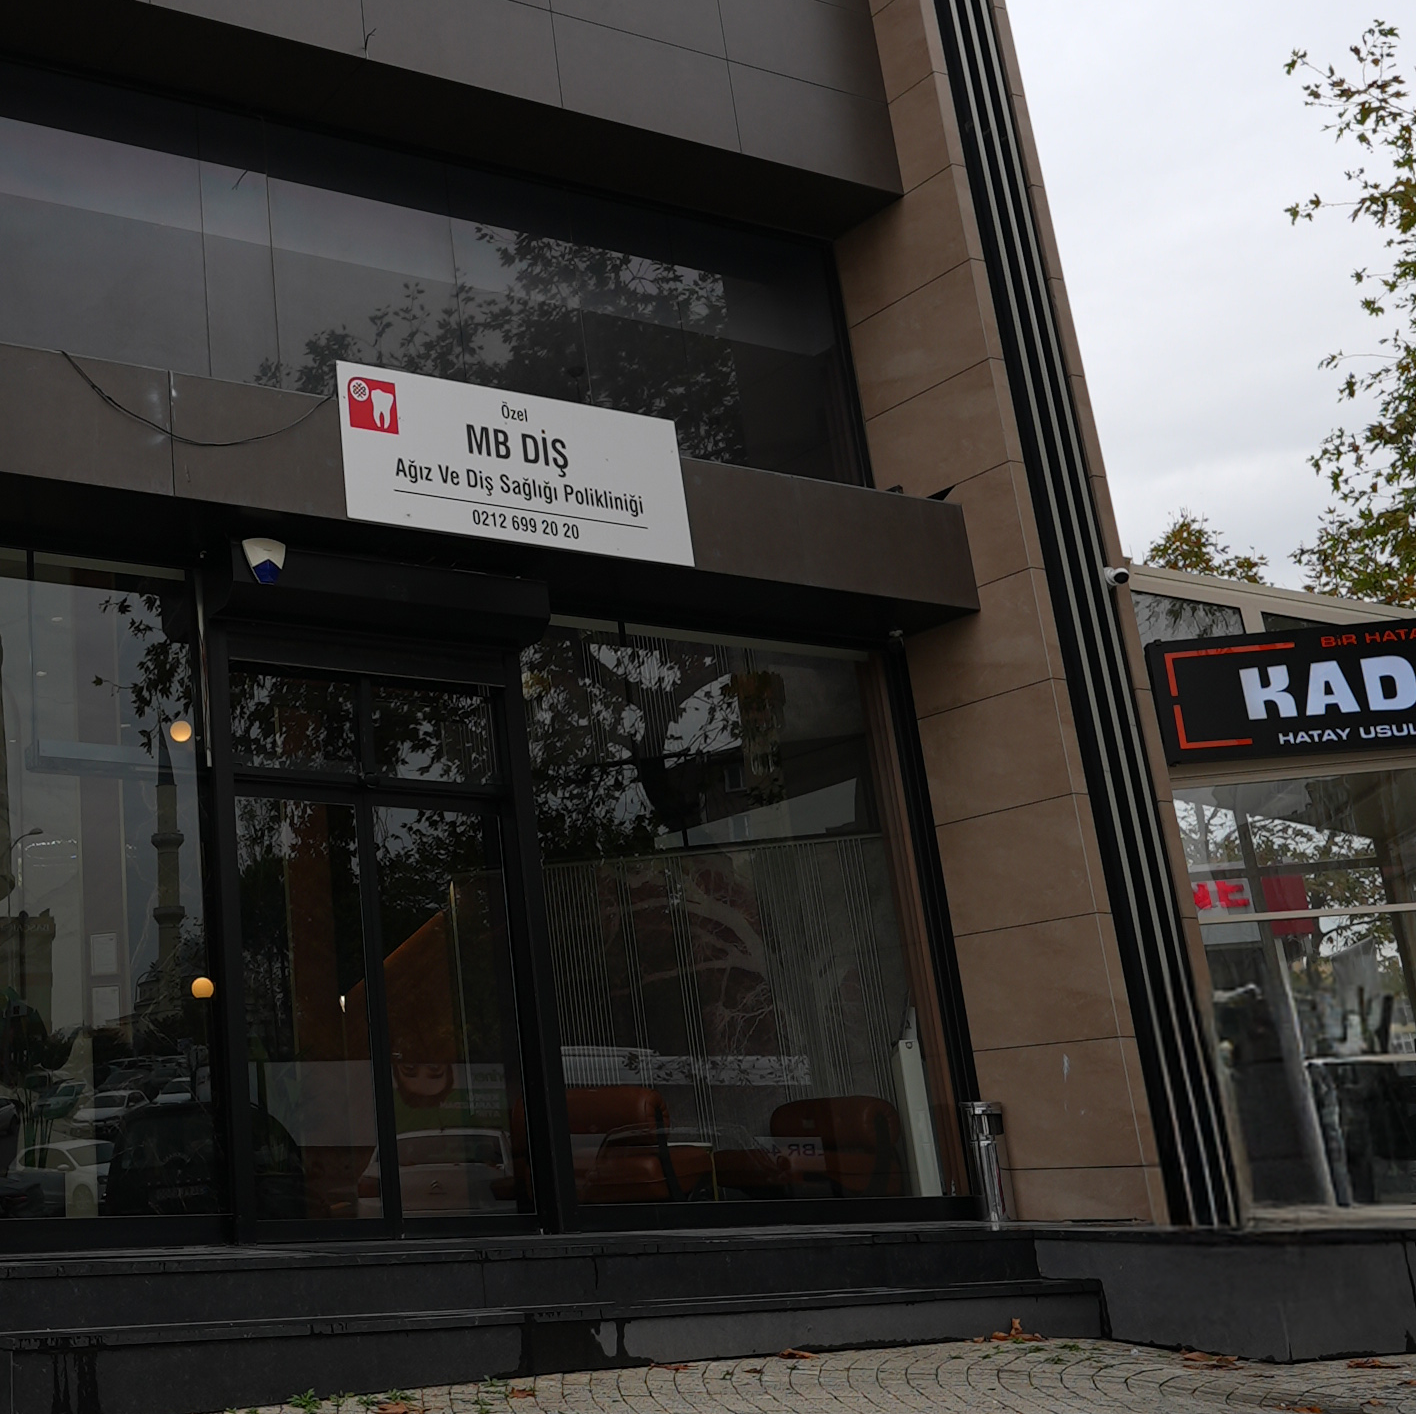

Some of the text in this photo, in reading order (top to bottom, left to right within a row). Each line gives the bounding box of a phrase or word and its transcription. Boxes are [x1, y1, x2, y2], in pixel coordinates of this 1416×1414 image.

[501, 400, 528, 423] Özel
[466, 424, 569, 478] MB DİŞ
[395, 458, 645, 517] Ağız Ve Diş Sağlığı Polikliniği
[472, 510, 580, 540] 0212 699 20 20
[1278, 727, 1351, 745] HATAY
